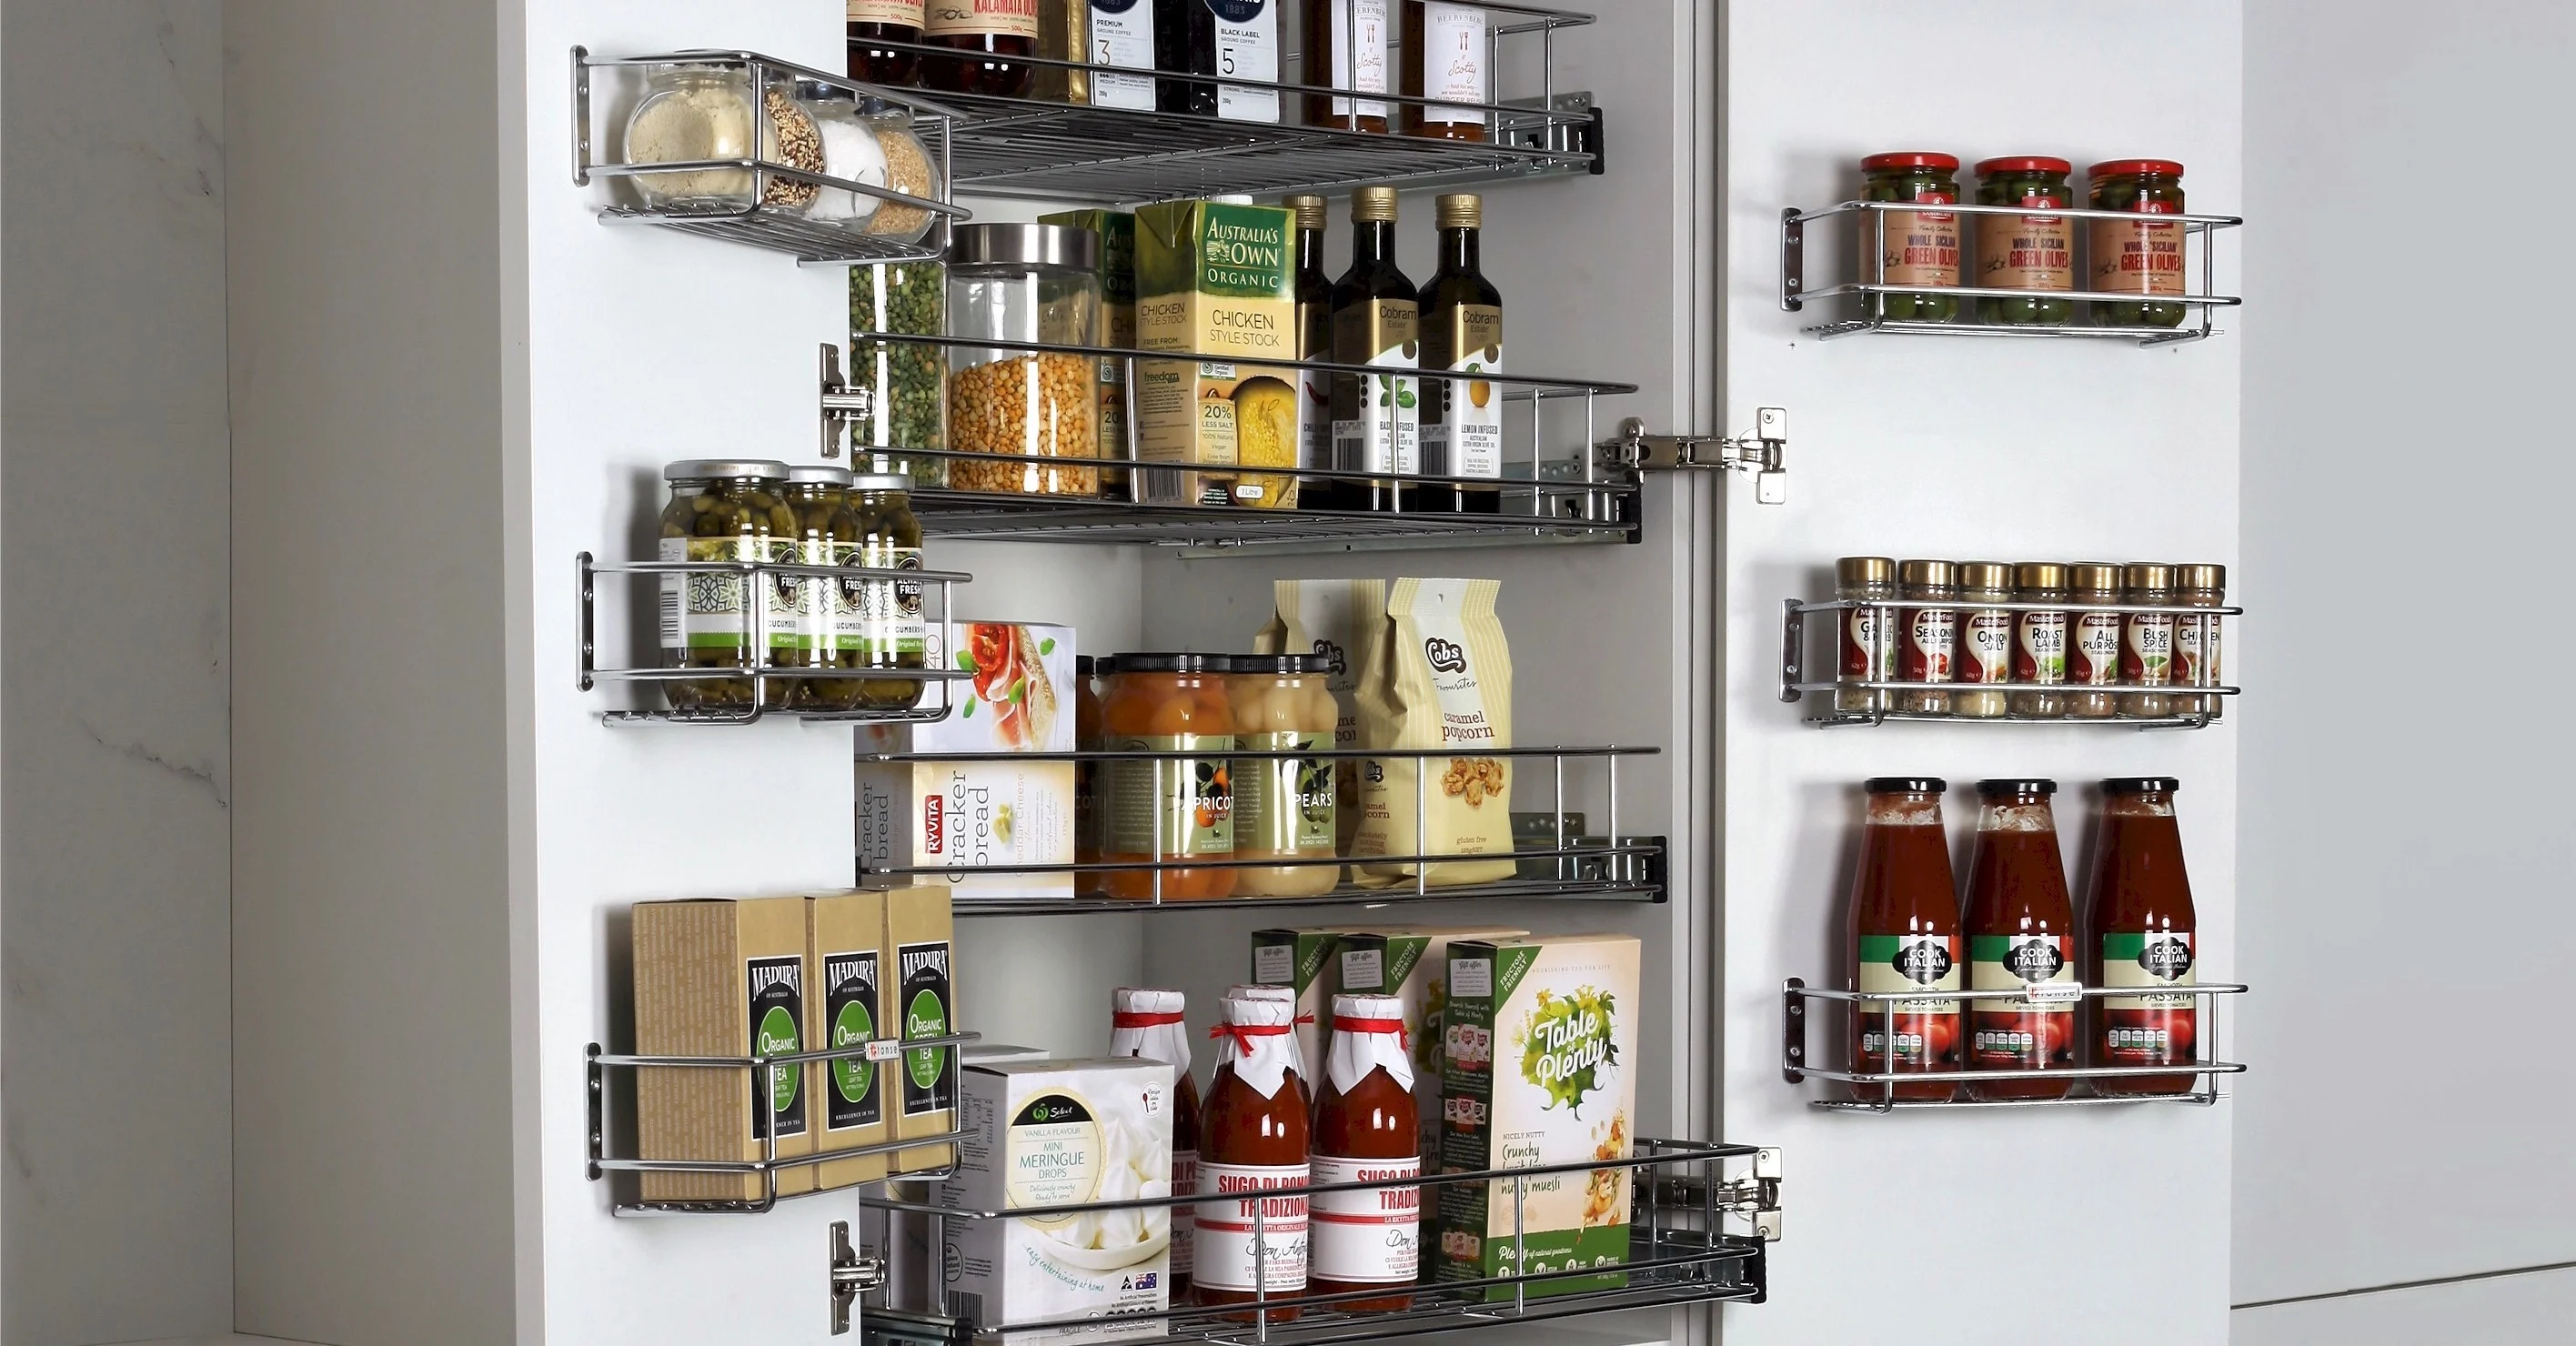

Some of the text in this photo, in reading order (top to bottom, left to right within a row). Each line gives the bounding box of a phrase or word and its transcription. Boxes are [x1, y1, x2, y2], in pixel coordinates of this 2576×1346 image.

[1098, 39, 1110, 65] 3
[1223, 48, 1234, 74] 5
[1207, 216, 1278, 244] AUSTRALIA'S
[1908, 235, 1931, 246] WHOLE
[2013, 237, 2037, 249] WHOLE
[1231, 243, 1278, 266] OWN
[1905, 247, 1936, 265] GREEN
[2009, 251, 2068, 267] GREEN OLIVES
[2157, 255, 2181, 271] OLIVES
[1208, 268, 1278, 288] ORGANIC
[1142, 303, 1185, 316] CHICKEN
[1380, 306, 1416, 319] Cobram
[1140, 316, 1161, 326] STYLE
[1162, 315, 1186, 325] STOCK
[1213, 310, 1273, 330] CHICKEN
[1463, 310, 1499, 325] Cobram
[1210, 329, 1280, 347] STYLE STOCK
[1204, 406, 1232, 419] 20%
[1462, 425, 1498, 434] LEMON INFUSED
[1977, 630, 2007, 642] ONION
[2032, 628, 2063, 639] ROAST
[2096, 629, 2113, 642] ALL
[2143, 628, 2168, 639] BUSH
[1984, 642, 2005, 651] SALT
[2036, 638, 2061, 647] LAMB
[2083, 640, 2118, 650] PURPOS
[2144, 640, 2168, 648] SPICE
[1427, 640, 1464, 669] Cobs
[1433, 678, 1477, 692] Favourites
[1444, 710, 1484, 725] caramel
[1442, 725, 1494, 742] popcorn
[1015, 773, 1025, 819] Cheese
[1294, 793, 1332, 807] PEARS
[873, 795, 888, 861] bread
[945, 770, 965, 883] Cracker
[1456, 835, 1487, 845] gluten free
[1909, 949, 1942, 959] COOK
[2019, 948, 2052, 958] COOK
[2155, 945, 2184, 955] COOK
[1391, 940, 1414, 976] FRUCTOSE
[1394, 946, 1416, 981] FRIENDLY
[1904, 958, 1946, 968] ITALIAN
[2015, 957, 2056, 966] ITALIAN
[2149, 954, 2188, 964] ITALIAN
[902, 949, 947, 986] MADURA
[1499, 950, 1525, 987] FRUCTOSE
[1503, 956, 1528, 992] FRIENDLY
[752, 964, 800, 1002] MADURA
[829, 959, 876, 997] MADURA
[911, 1014, 941, 1034] ORGANIC
[838, 1026, 870, 1046] ORGANIC
[1535, 1010, 1598, 1053] Table
[761, 1031, 795, 1053] ORGANIC
[920, 1048, 933, 1060] TEA
[848, 1060, 862, 1073] TEA
[1536, 1037, 1607, 1089] Plenty
[835, 1111, 862, 1120] EXCELLENCE
[1025, 1127, 1081, 1137] VANILLA FLAVOUR
[1525, 1130, 1545, 1139] NUTTY
[1043, 1141, 1062, 1151] MINI
[1502, 1141, 1539, 1164] Crunchy
[1019, 1151, 1084, 1169] MERINGUE
[1039, 1168, 1067, 1179] DROPS
[1030, 1183, 1076, 1195] Deliciously crunchy
[1219, 1175, 1259, 1192] SUGO
[1263, 1177, 1277, 1190] DI
[1501, 1175, 1561, 1200] nuy muesli
[1035, 1193, 1051, 1203] Ready
[1535, 1248, 1552, 1257] natural
[1552, 1247, 1572, 1257] goodness
[1026, 1246, 1104, 1291] easy entertaining at home
